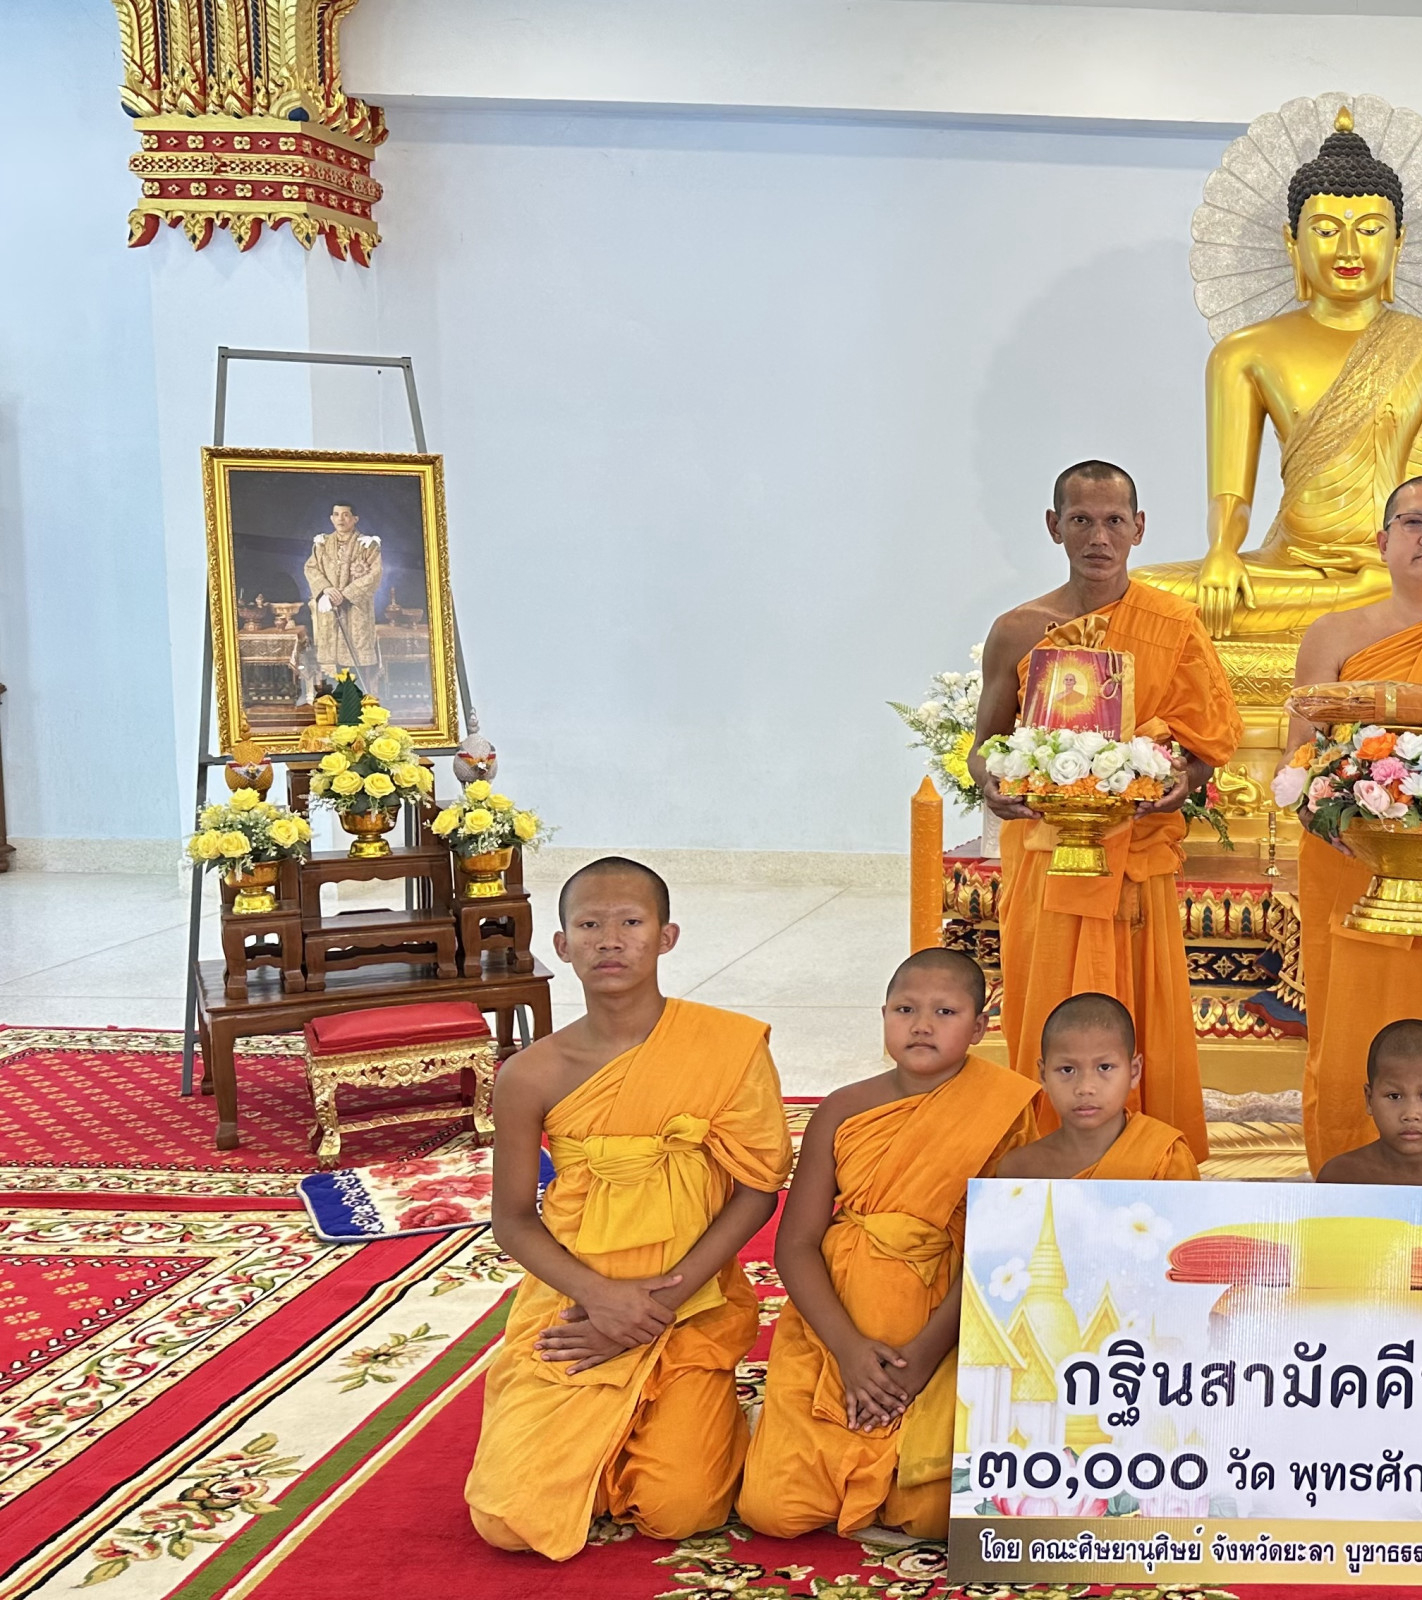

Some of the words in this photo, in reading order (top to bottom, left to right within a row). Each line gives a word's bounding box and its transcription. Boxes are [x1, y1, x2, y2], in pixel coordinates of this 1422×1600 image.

[978, 1451, 1209, 1500] ๓๐,๐๐๐
[1226, 1446, 1275, 1491] วัด
[980, 1531, 1021, 1561] โดย
[1031, 1526, 1204, 1572] คณะศิษยานุศิษย์
[1211, 1533, 1335, 1562] จังหวัดยะลา
